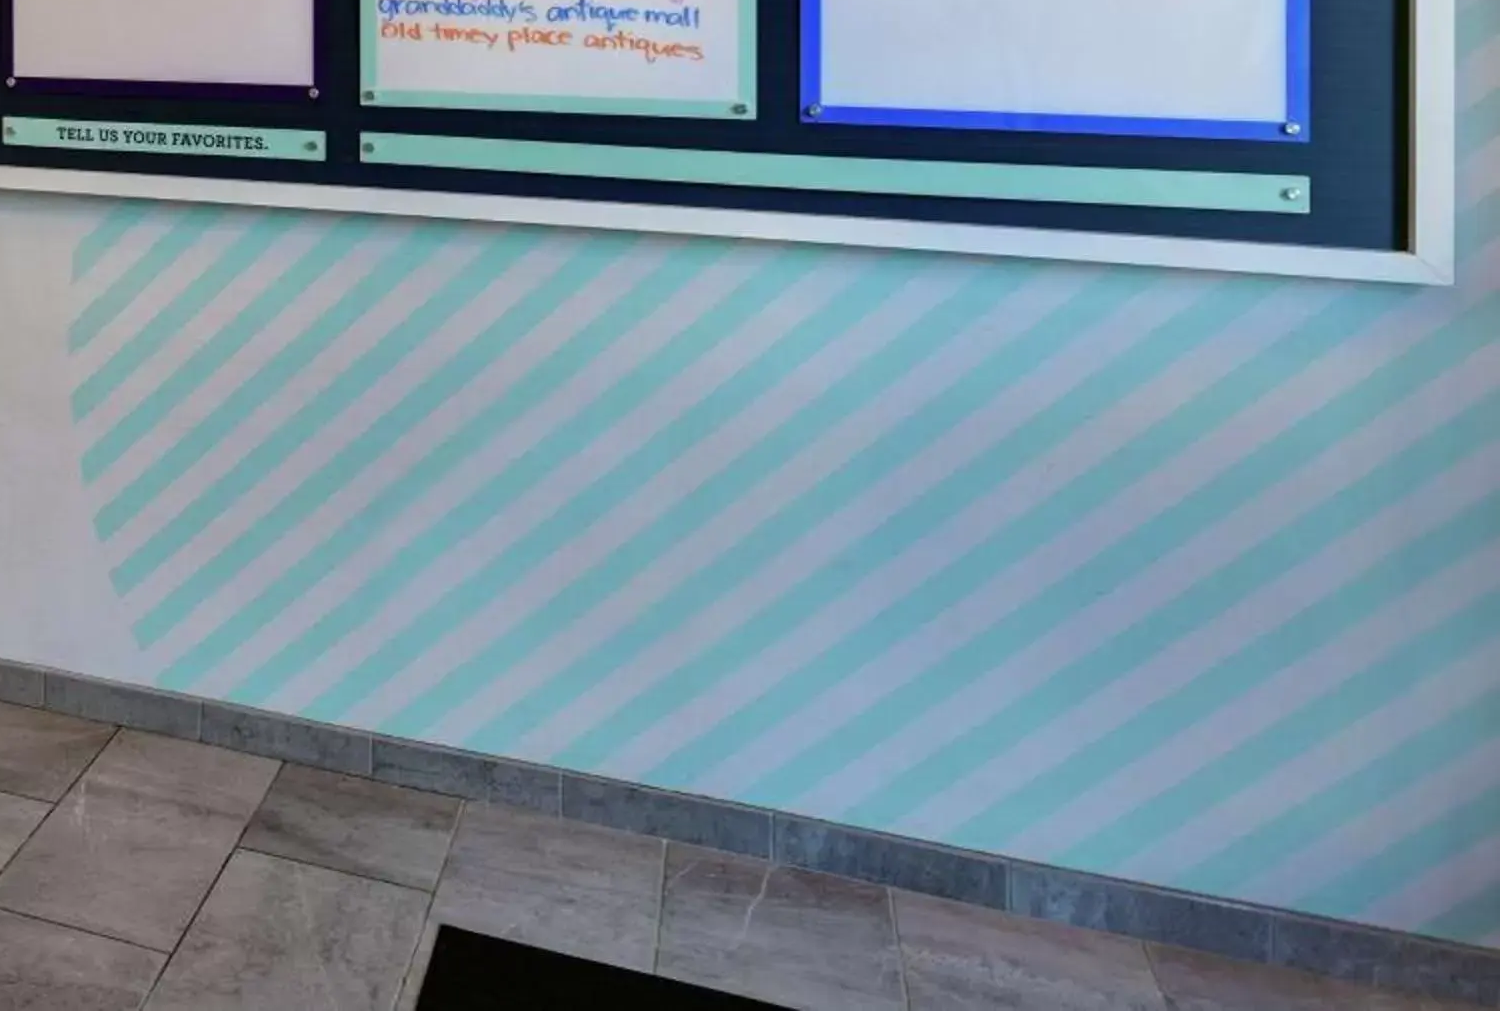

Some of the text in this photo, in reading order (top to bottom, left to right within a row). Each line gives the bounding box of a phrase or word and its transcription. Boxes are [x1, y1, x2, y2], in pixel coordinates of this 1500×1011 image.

[645, 6, 700, 29] mall
[507, 27, 574, 52] place
[584, 30, 705, 63] antiques
[55, 126, 270, 151] TELL US YOUR FAVORITES.
